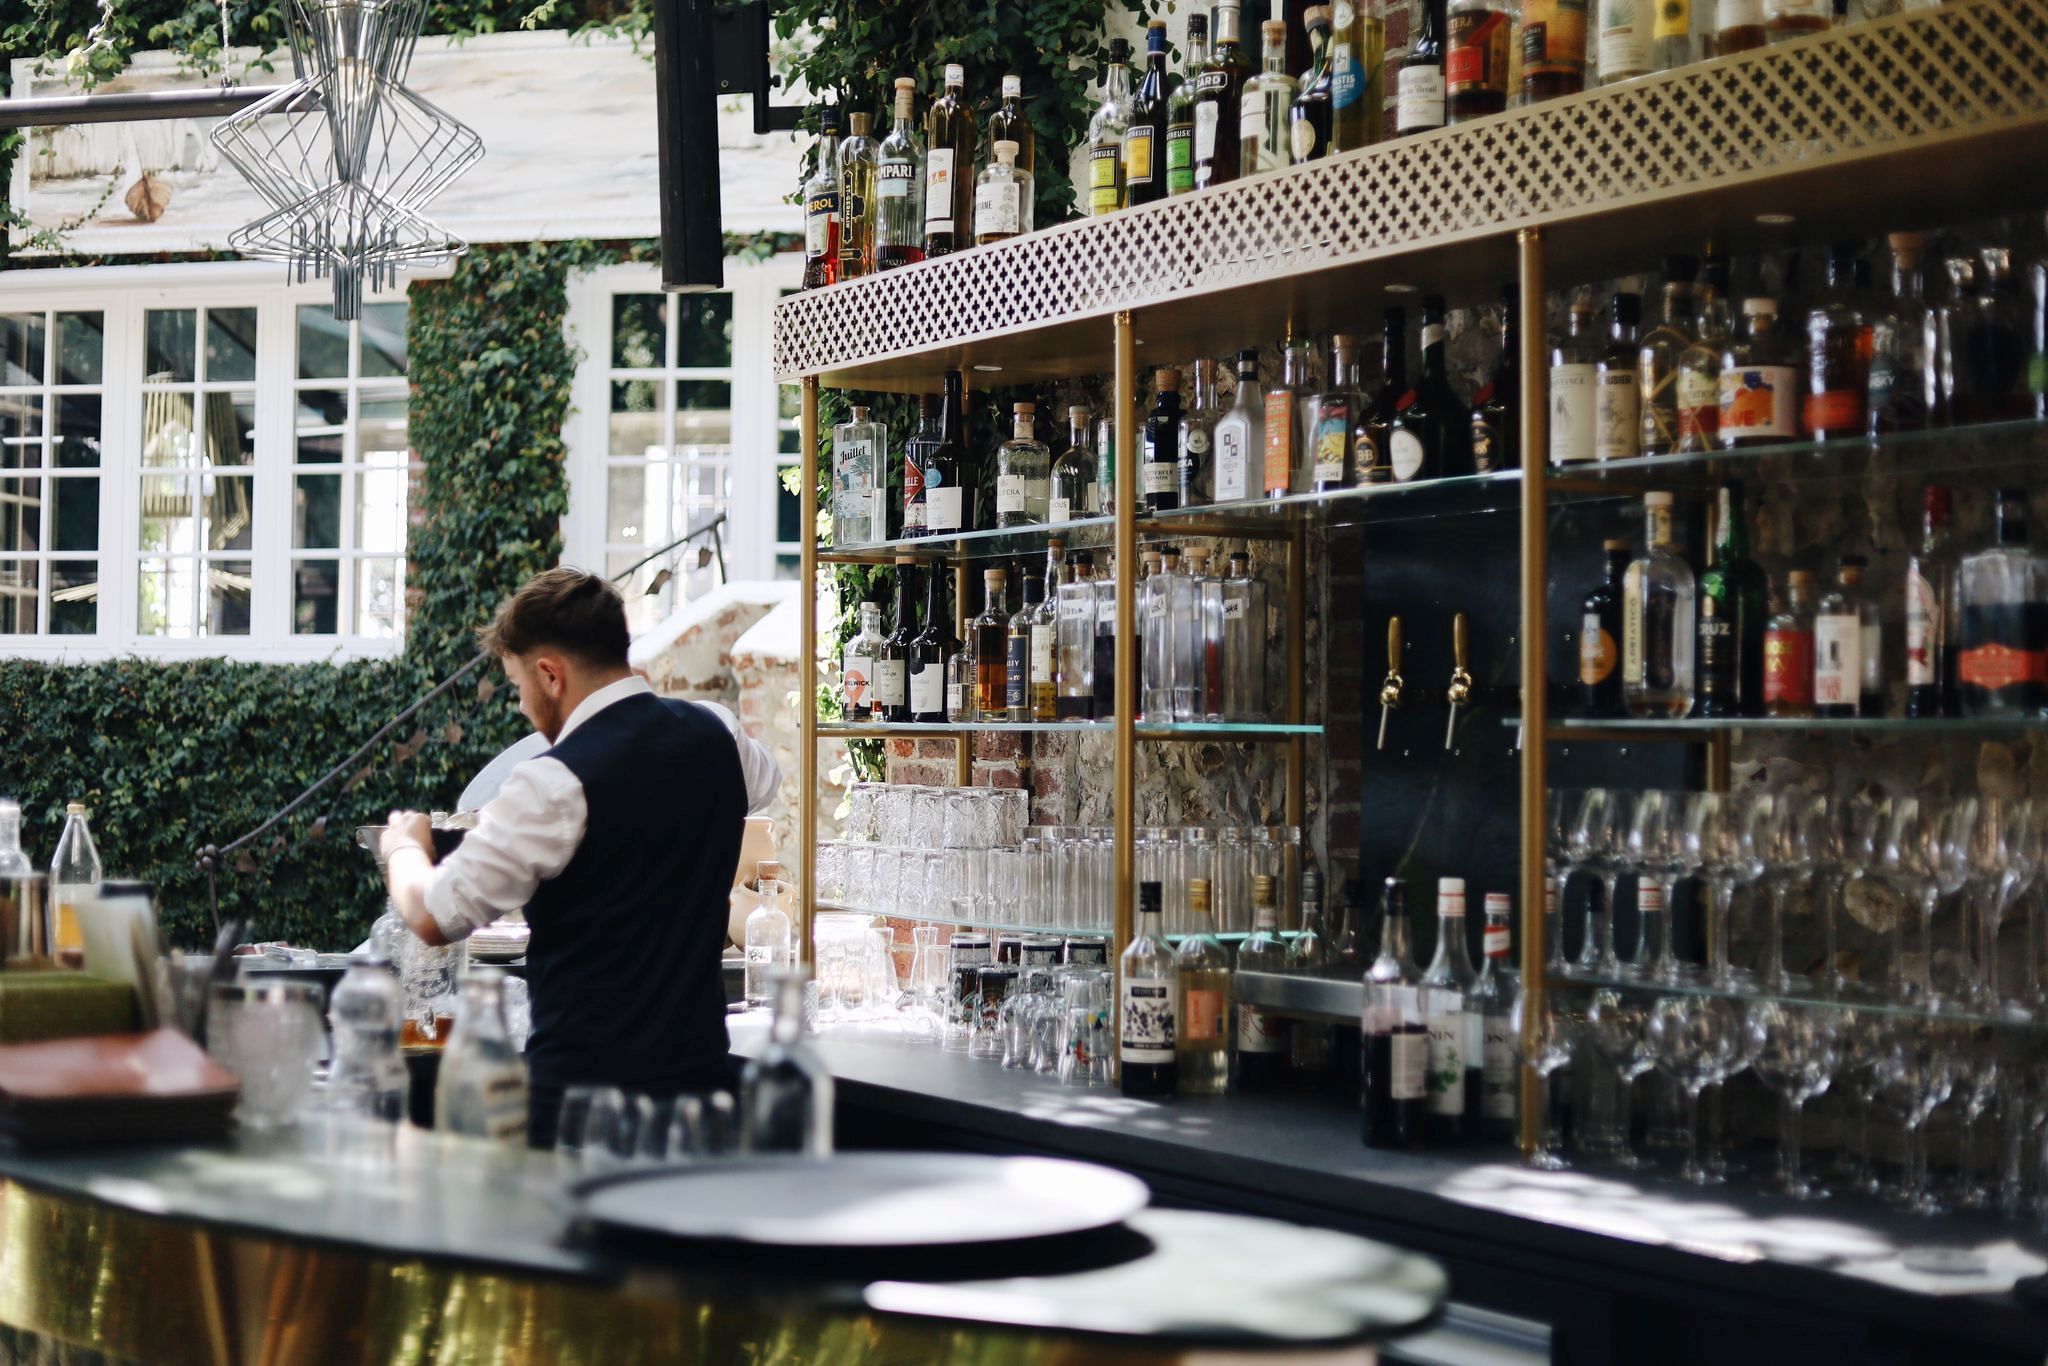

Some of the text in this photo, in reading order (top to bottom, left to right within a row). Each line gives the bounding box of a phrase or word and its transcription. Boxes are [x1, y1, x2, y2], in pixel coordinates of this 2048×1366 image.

[878, 164, 913, 179] MPARI
[808, 198, 834, 213] EROL
[840, 445, 866, 466] Juillet
